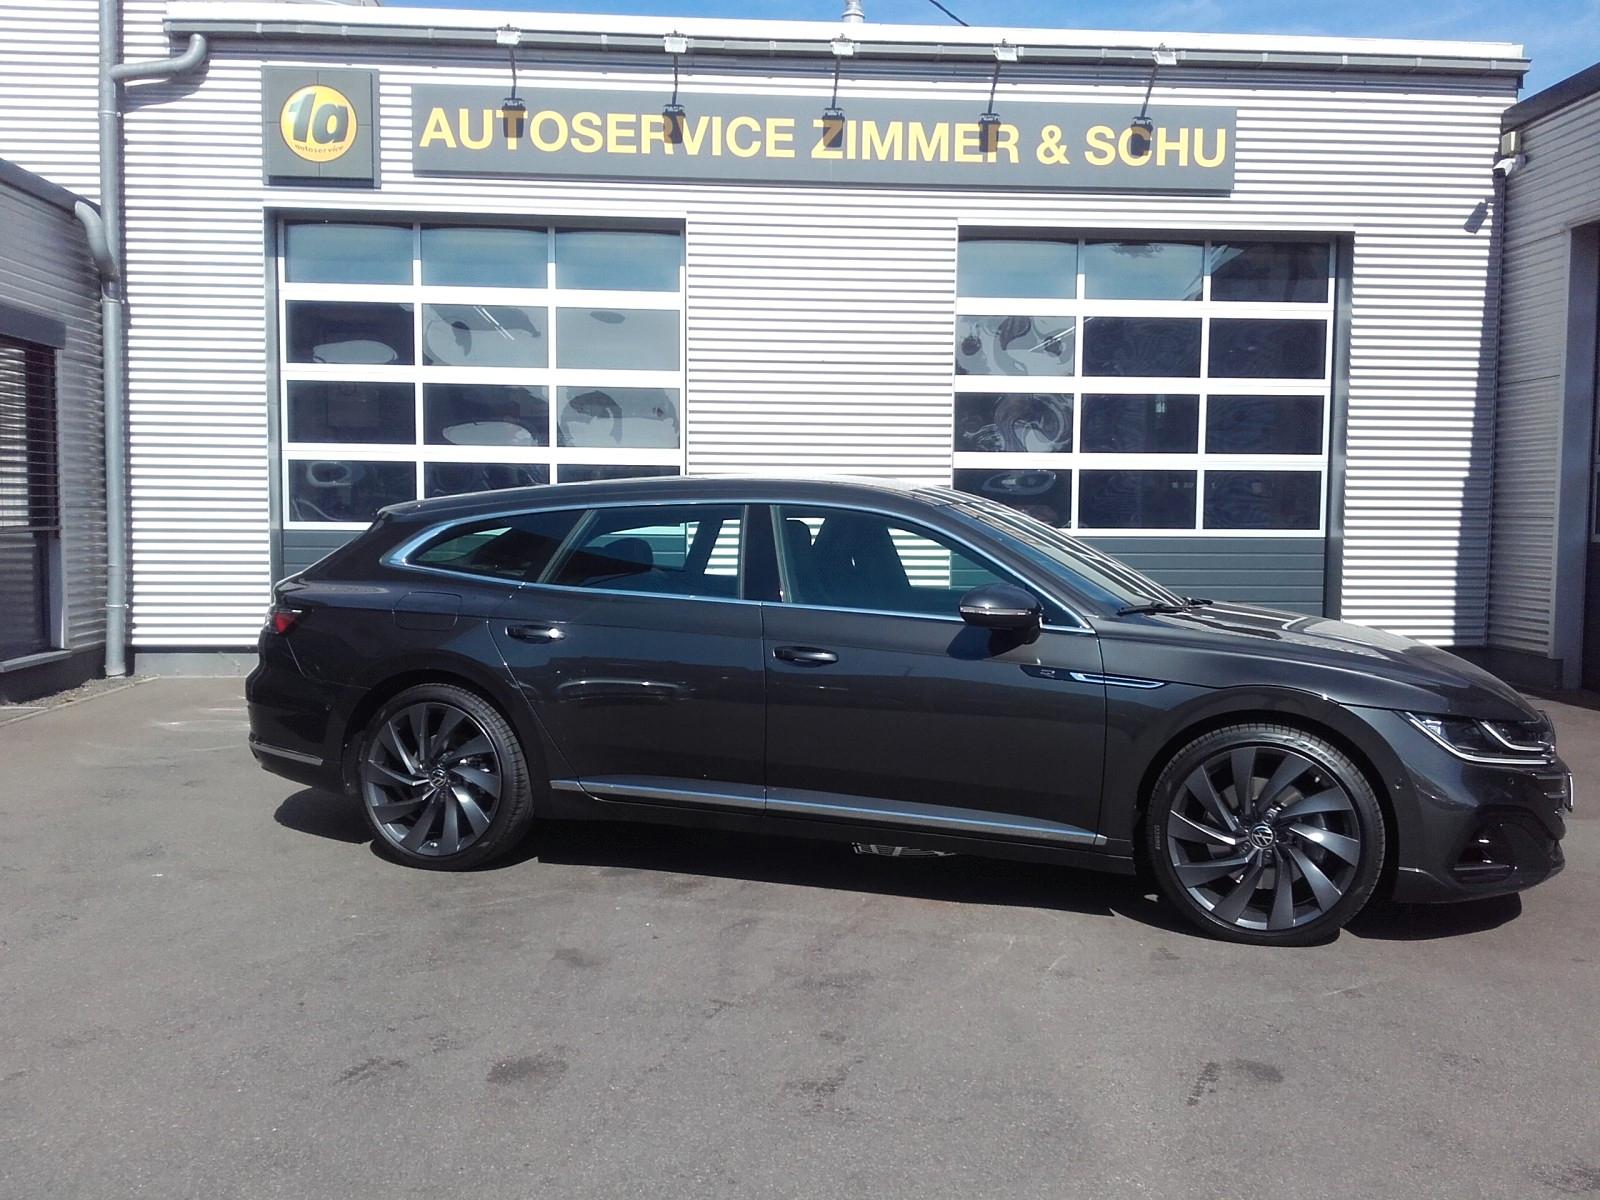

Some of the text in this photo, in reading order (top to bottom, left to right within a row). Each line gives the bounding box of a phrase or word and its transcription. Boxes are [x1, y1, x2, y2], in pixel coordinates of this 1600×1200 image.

[287, 92, 349, 145] 1a
[419, 107, 1227, 168] AUTOSERVICE ZIMMER & SCHU
